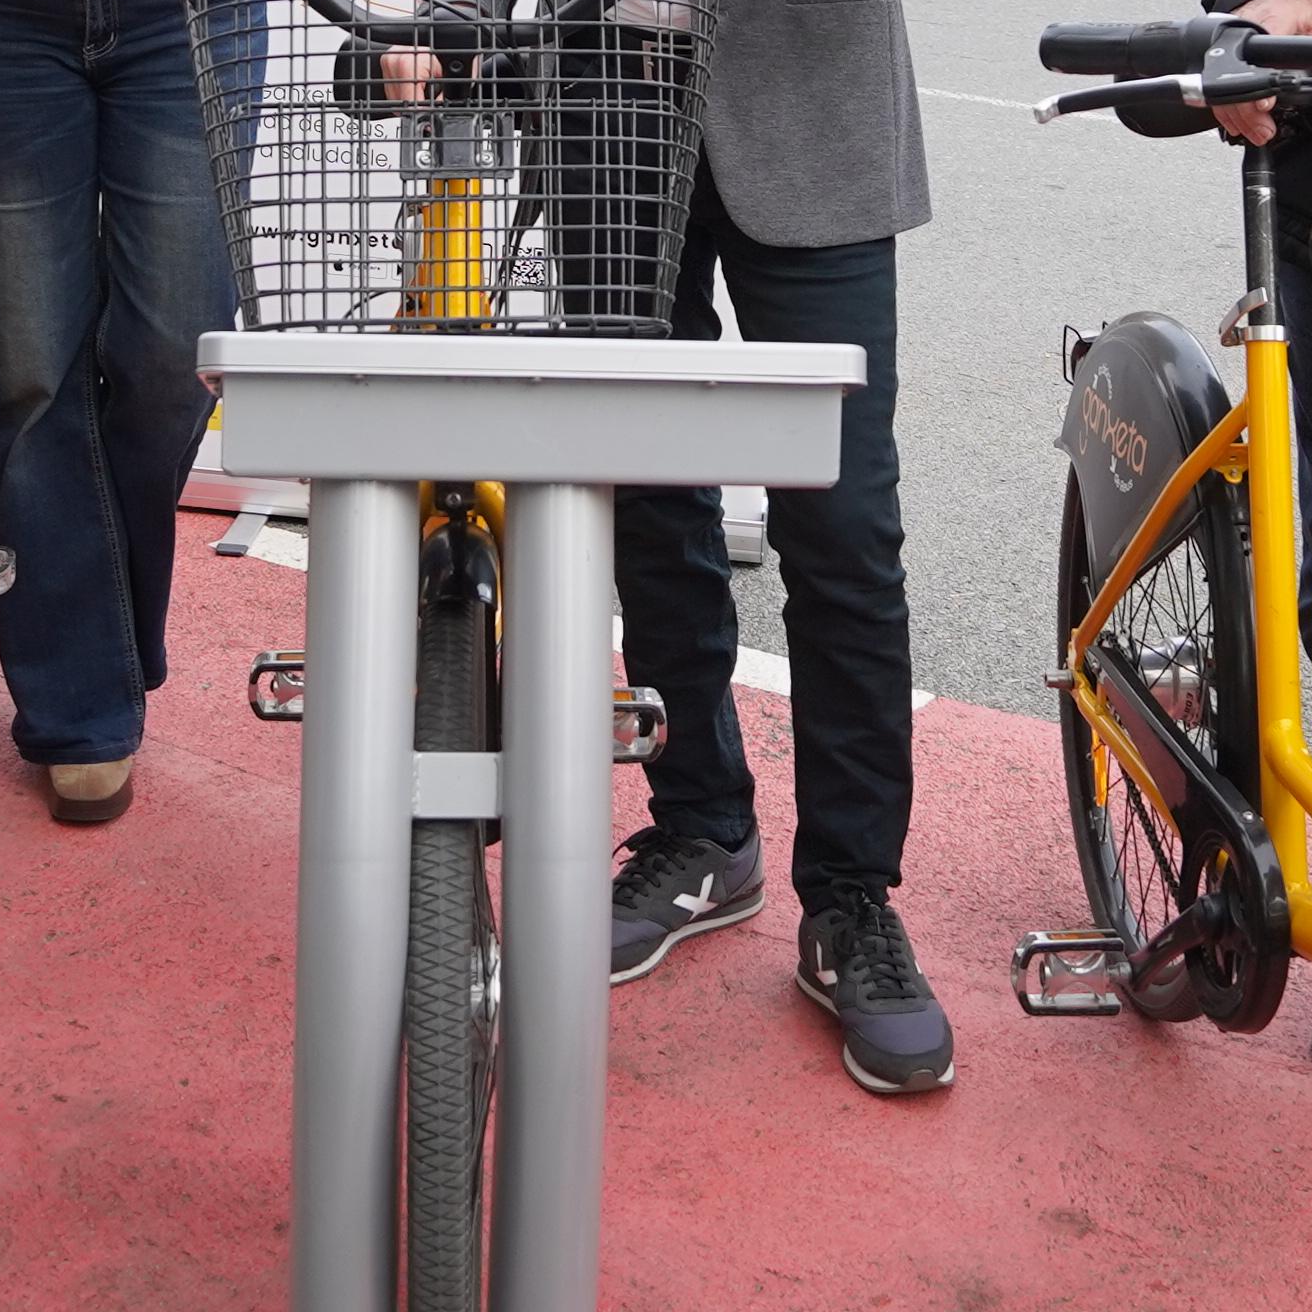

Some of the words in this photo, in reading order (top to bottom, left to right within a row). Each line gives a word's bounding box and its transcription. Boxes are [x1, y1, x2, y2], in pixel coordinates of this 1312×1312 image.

[299, 114, 323, 134] de
[334, 117, 388, 141] Reus,
[281, 144, 392, 170] saludable,
[1079, 386, 1148, 476] ganxeta
